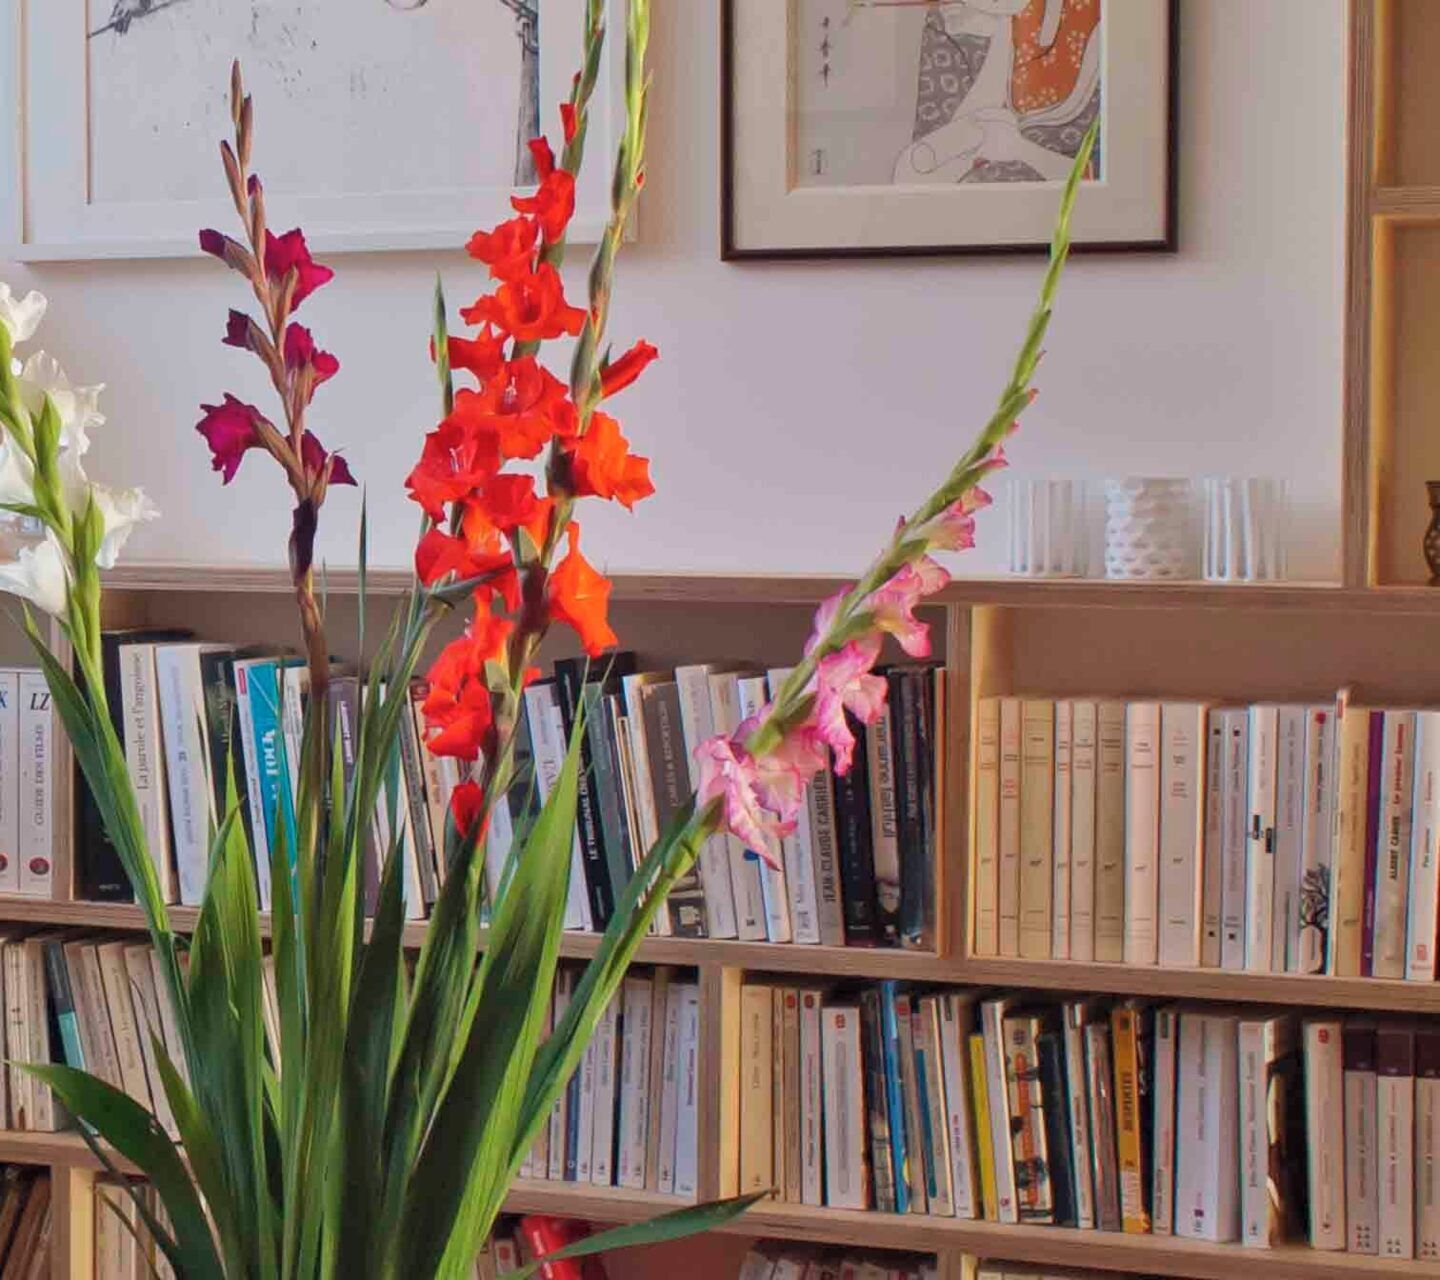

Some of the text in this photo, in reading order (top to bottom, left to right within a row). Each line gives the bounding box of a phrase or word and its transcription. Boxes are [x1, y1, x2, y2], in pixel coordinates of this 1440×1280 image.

[30, 691, 52, 710] LZ
[134, 716, 145, 729] et
[134, 732, 150, 772] parole
[34, 724, 44, 825] GUIDE DES FILMS
[135, 773, 149, 791] La
